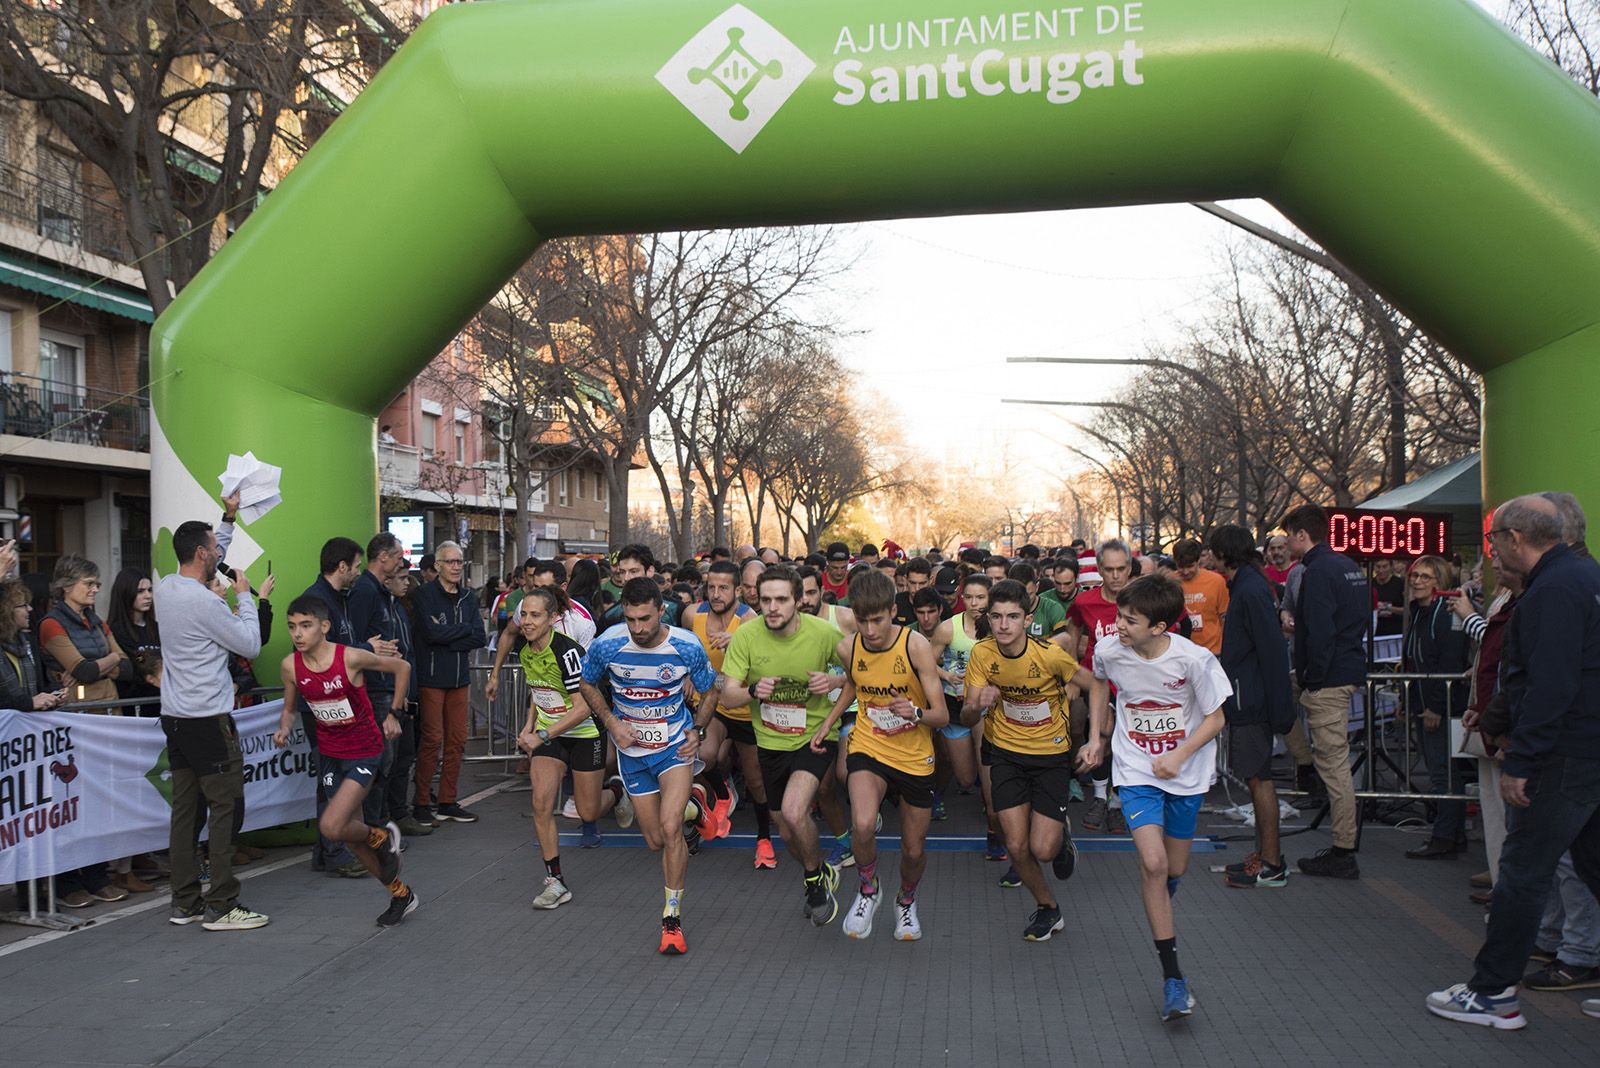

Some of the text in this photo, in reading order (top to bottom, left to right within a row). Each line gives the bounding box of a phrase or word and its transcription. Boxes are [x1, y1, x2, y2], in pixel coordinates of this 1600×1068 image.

[832, 2, 1144, 55] AJUNTAMENT DE
[832, 39, 1145, 106] SantCugat
[1330, 513, 1445, 555] 0:00:01
[42, 726, 75, 758] DEL
[1133, 716, 1178, 733] 2146
[23, 795, 80, 839] CUGAT
